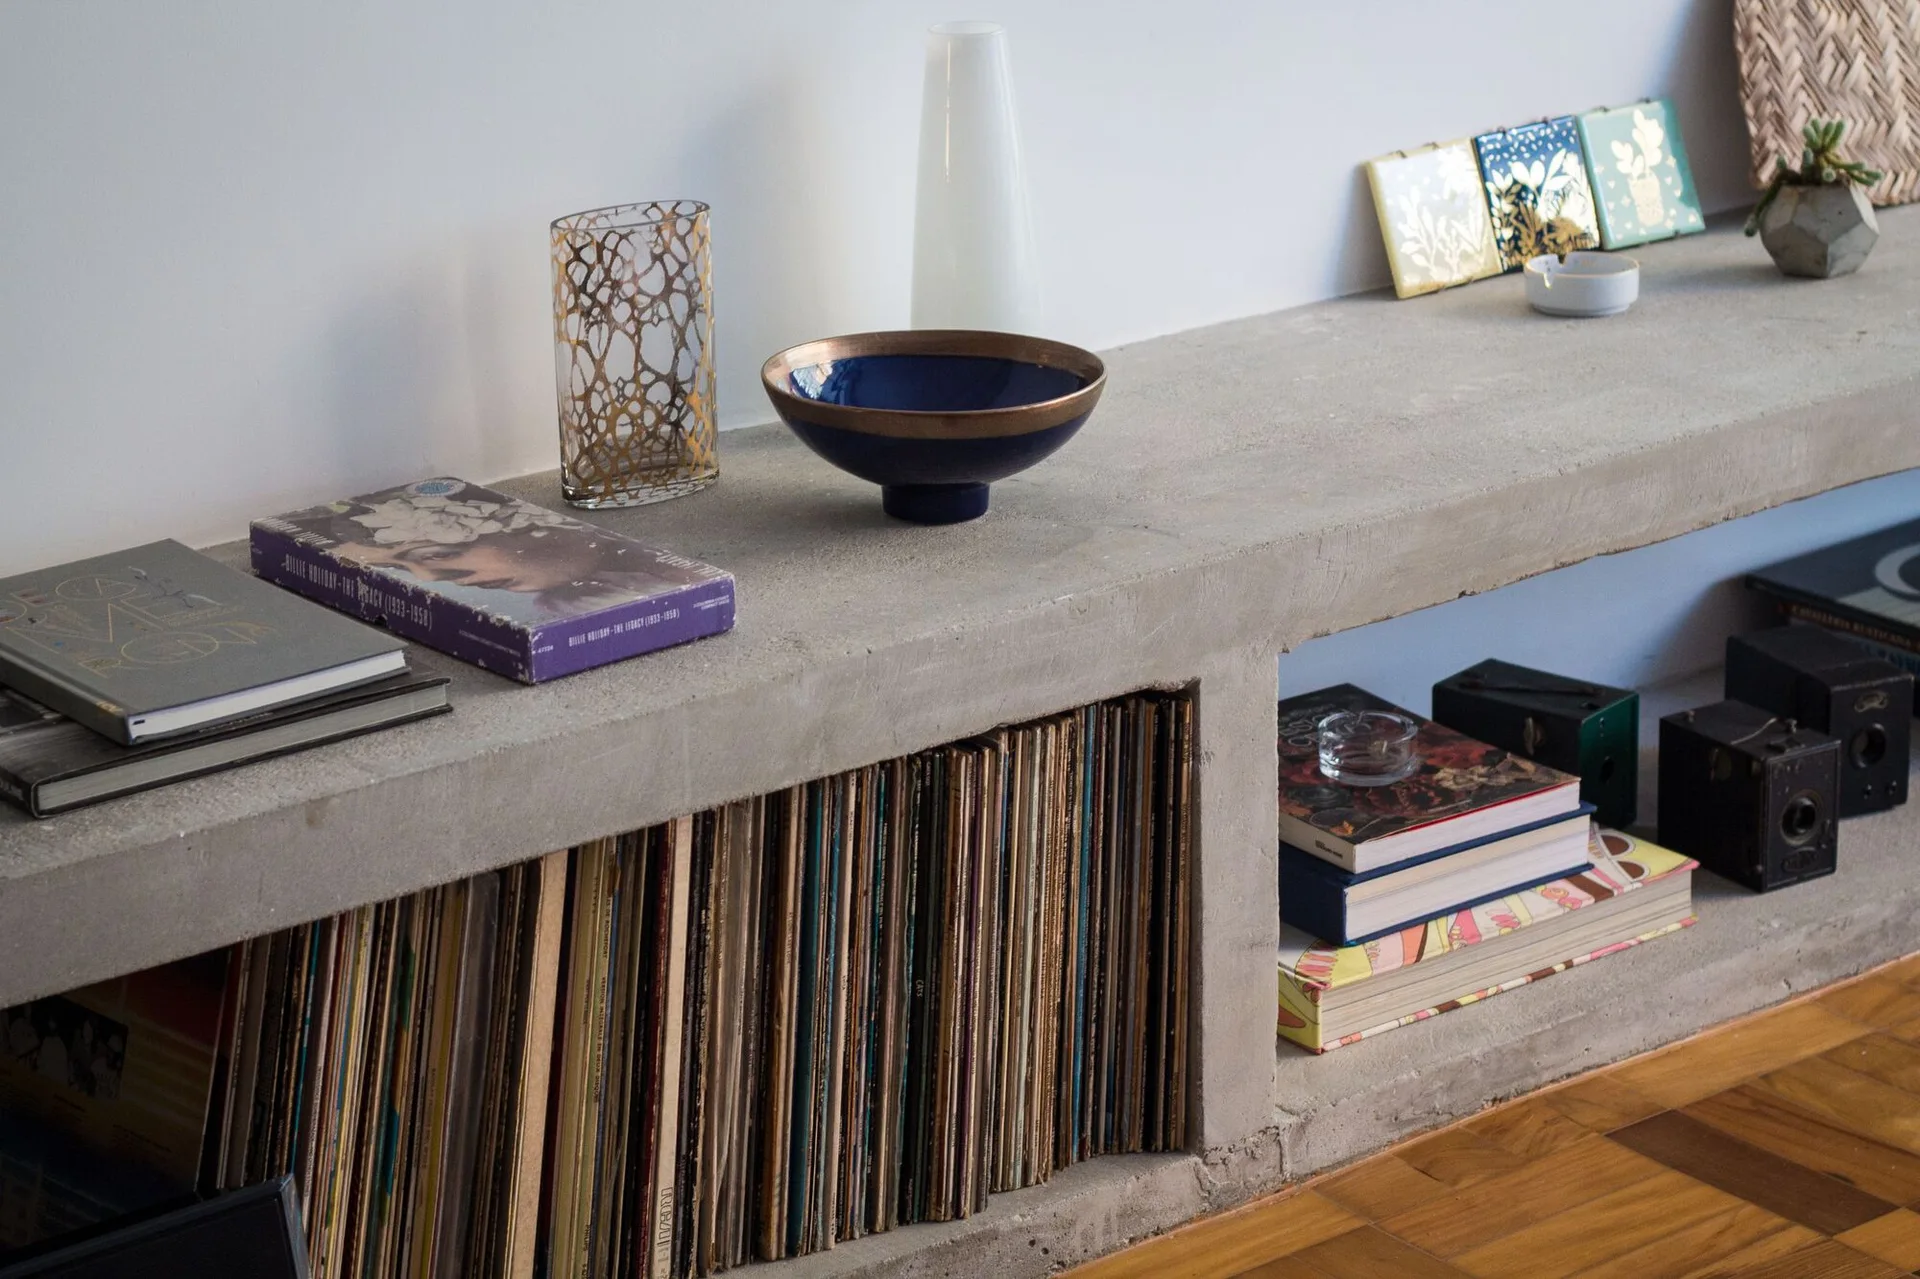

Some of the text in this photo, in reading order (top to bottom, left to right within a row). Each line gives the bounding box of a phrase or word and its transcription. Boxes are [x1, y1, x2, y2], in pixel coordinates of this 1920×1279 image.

[285, 553, 306, 579] BILLIE
[568, 633, 586, 647] BILLIE
[625, 618, 645, 632] LEGACY
[915, 979, 923, 997] CATS
